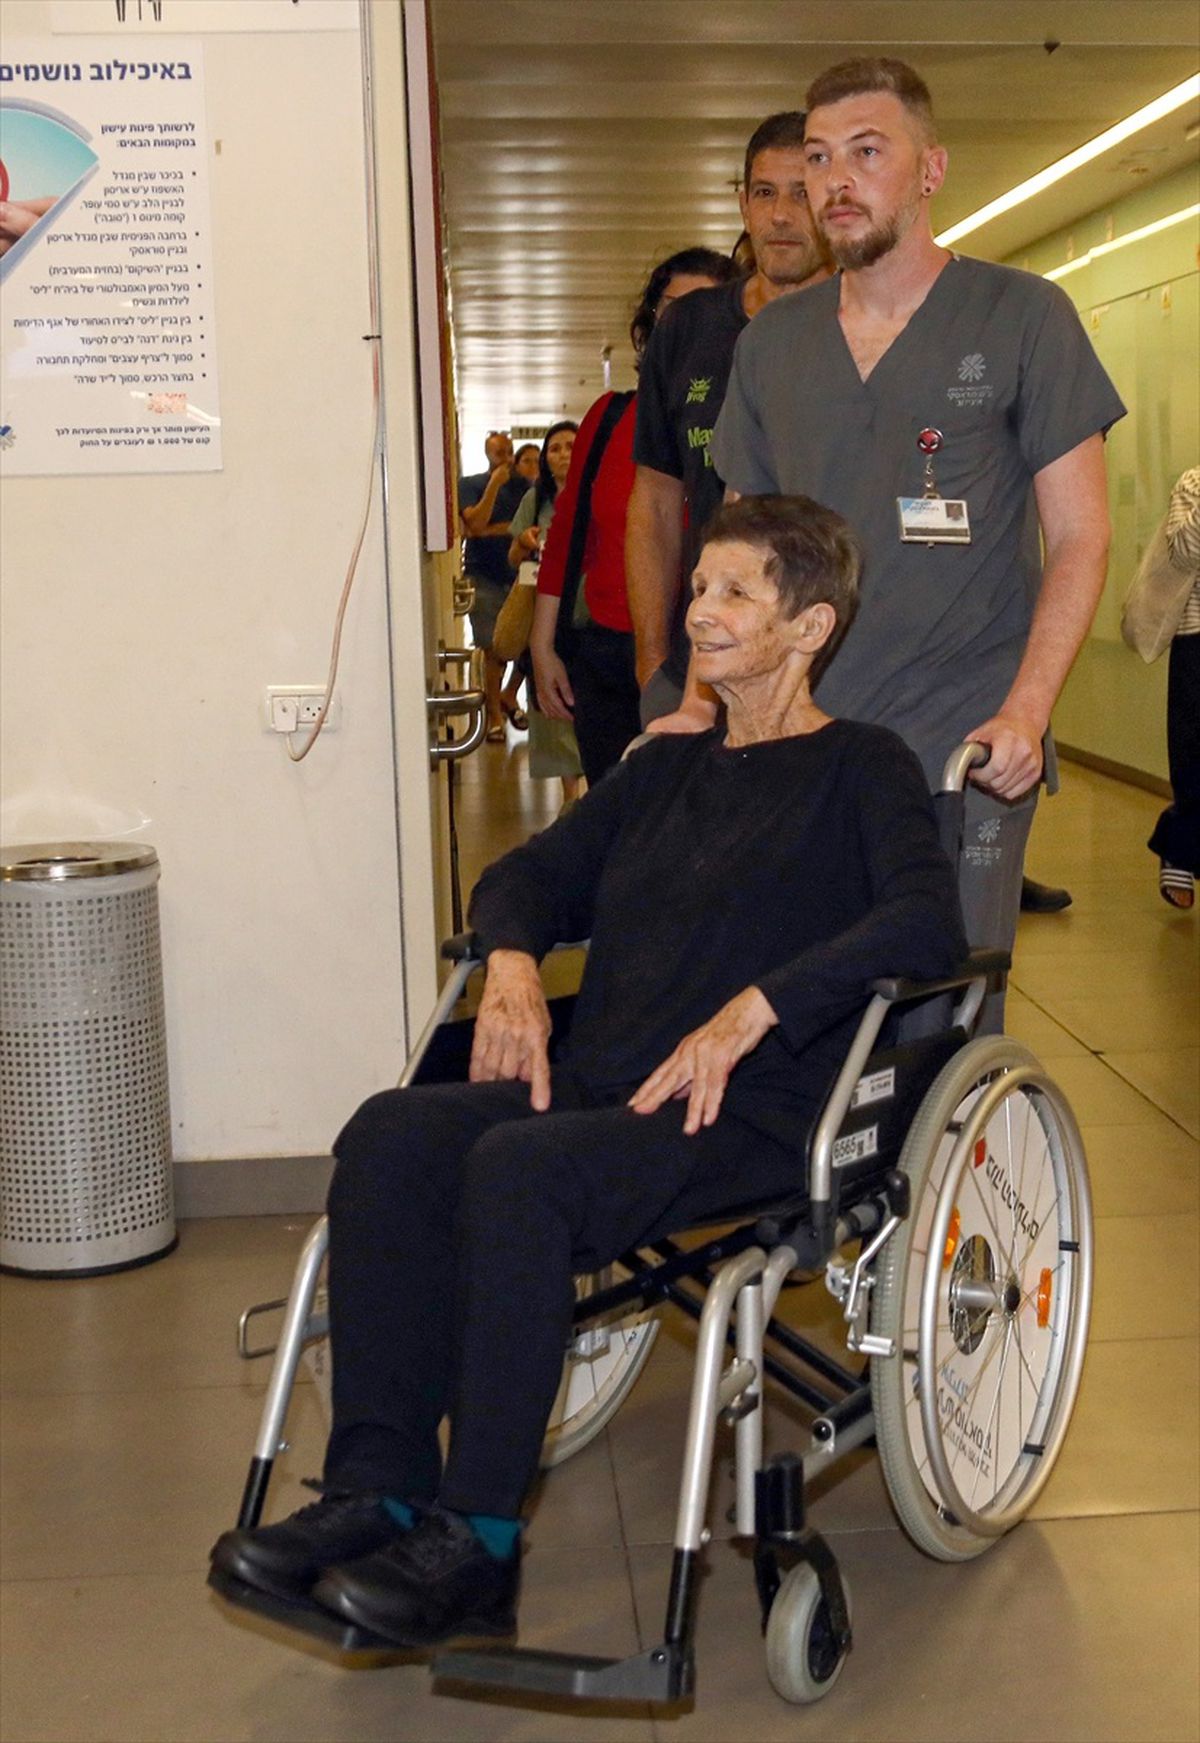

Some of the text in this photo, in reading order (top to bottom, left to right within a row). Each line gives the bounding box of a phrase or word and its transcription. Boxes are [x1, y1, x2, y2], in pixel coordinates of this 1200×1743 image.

[0, 59, 192, 82] באיכילוב נושמים
[101, 122, 195, 135] לרשותך פינות עישון
[153, 138, 196, 149] במקומות
[112, 170, 184, 183] בכיכר שבין מגדל
[151, 185, 185, 194] האשפוז
[104, 200, 121, 209] סמי
[142, 198, 160, 208] הלב
[162, 198, 185, 210] לבניין
[138, 213, 162, 222] מינוס
[163, 213, 186, 224] קומה
[74, 232, 98, 242] מגדל
[97, 233, 119, 244] שבין
[120, 232, 155, 241] הפנימית
[157, 232, 187, 241] ברחבה
[129, 246, 187, 257] ובניין סוראסקי
[48, 265, 93, 276] המערבית)
[93, 264, 123, 275] (בחזית
[165, 264, 189, 276] בבניין
[80, 283, 94, 294] של
[96, 283, 147, 293] האמבולטורי
[148, 282, 173, 295] המיון
[172, 282, 190, 293] מעל
[158, 296, 189, 306] ליולדות
[13, 318, 45, 328] הדימות
[46, 316, 66, 329] אגף
[66, 317, 80, 326] של
[80, 317, 111, 326] האחורי
[112, 315, 135, 326] לצידו
[161, 316, 178, 327] בניין
[179, 315, 192, 327] בין
[80, 335, 108, 345] לסיעוד
[162, 334, 179, 343] גינת
[181, 334, 192, 346] בין
[36, 355, 71, 365] תחבורה
[72, 354, 107, 366] ומחלקת
[171, 353, 193, 365] סמוך
